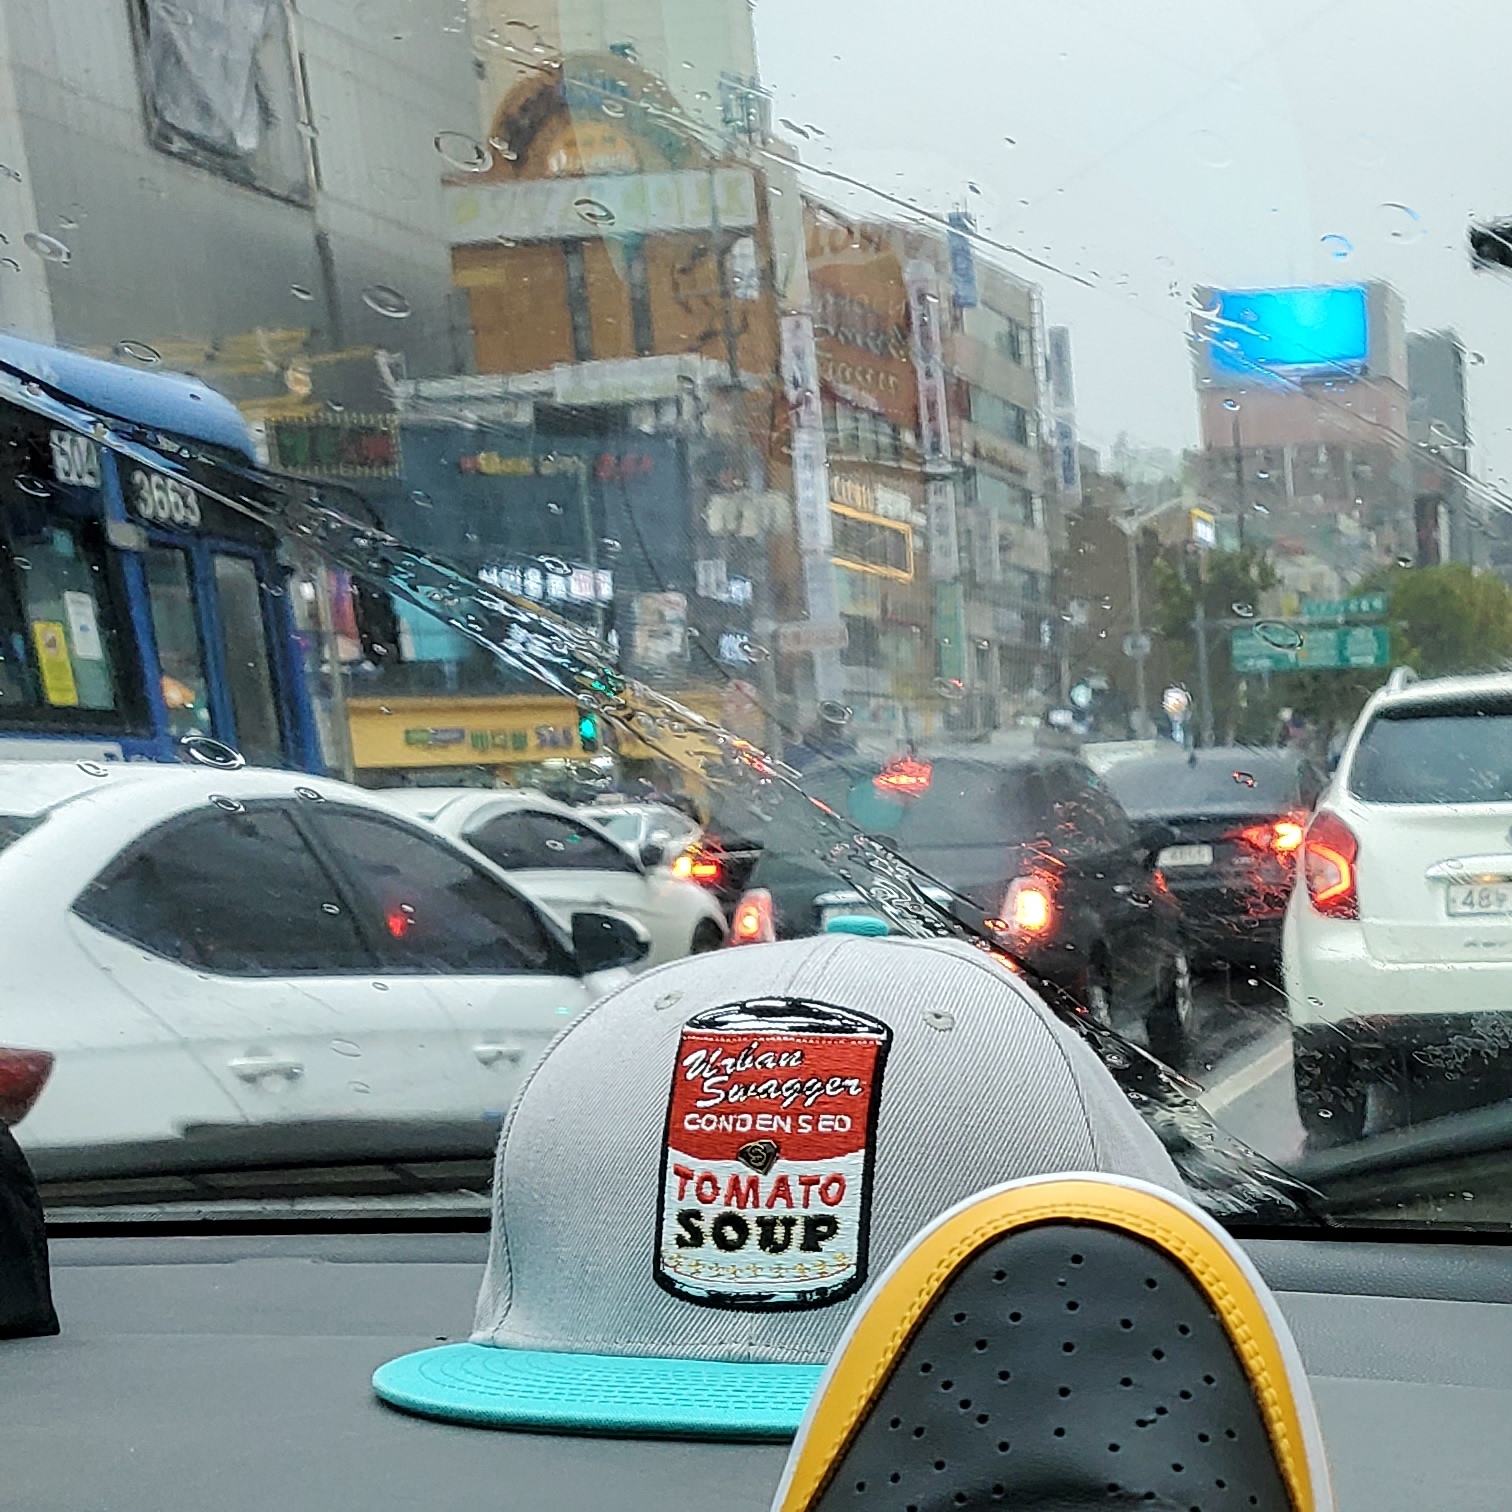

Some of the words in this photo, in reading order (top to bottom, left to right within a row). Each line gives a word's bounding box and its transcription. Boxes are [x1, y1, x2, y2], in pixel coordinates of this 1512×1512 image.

[131, 469, 201, 527] 3663
[682, 1041, 803, 1081] Urban
[695, 1076, 863, 1109] Swagger
[683, 1113, 852, 1134] CONDENSED
[672, 1163, 847, 1210] TOMATO
[674, 1208, 840, 1255] SOUP
